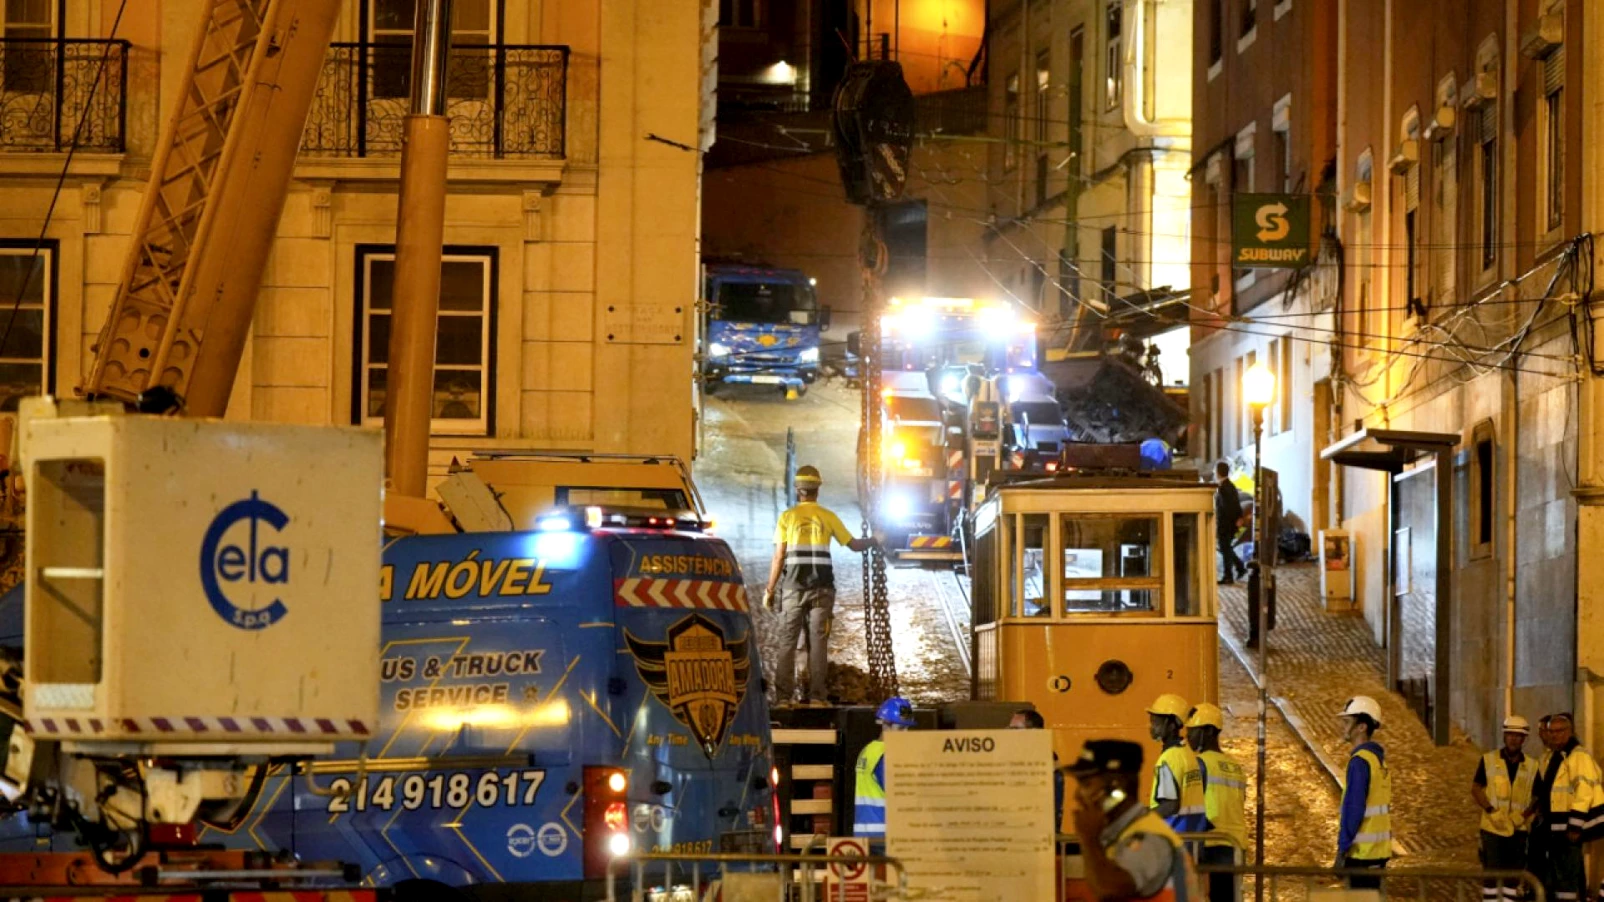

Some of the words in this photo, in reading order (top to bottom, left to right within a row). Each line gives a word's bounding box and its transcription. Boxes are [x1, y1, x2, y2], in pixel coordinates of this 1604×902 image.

[1238, 248, 1306, 261] SUBWAY
[404, 549, 552, 600] MÓVEL
[422, 656, 443, 680] &
[451, 650, 545, 678] TRUCK
[669, 658, 736, 699] AMADORA
[1167, 670, 1174, 679] 2
[395, 683, 509, 711] SERVICE
[942, 736, 995, 753] AVISO
